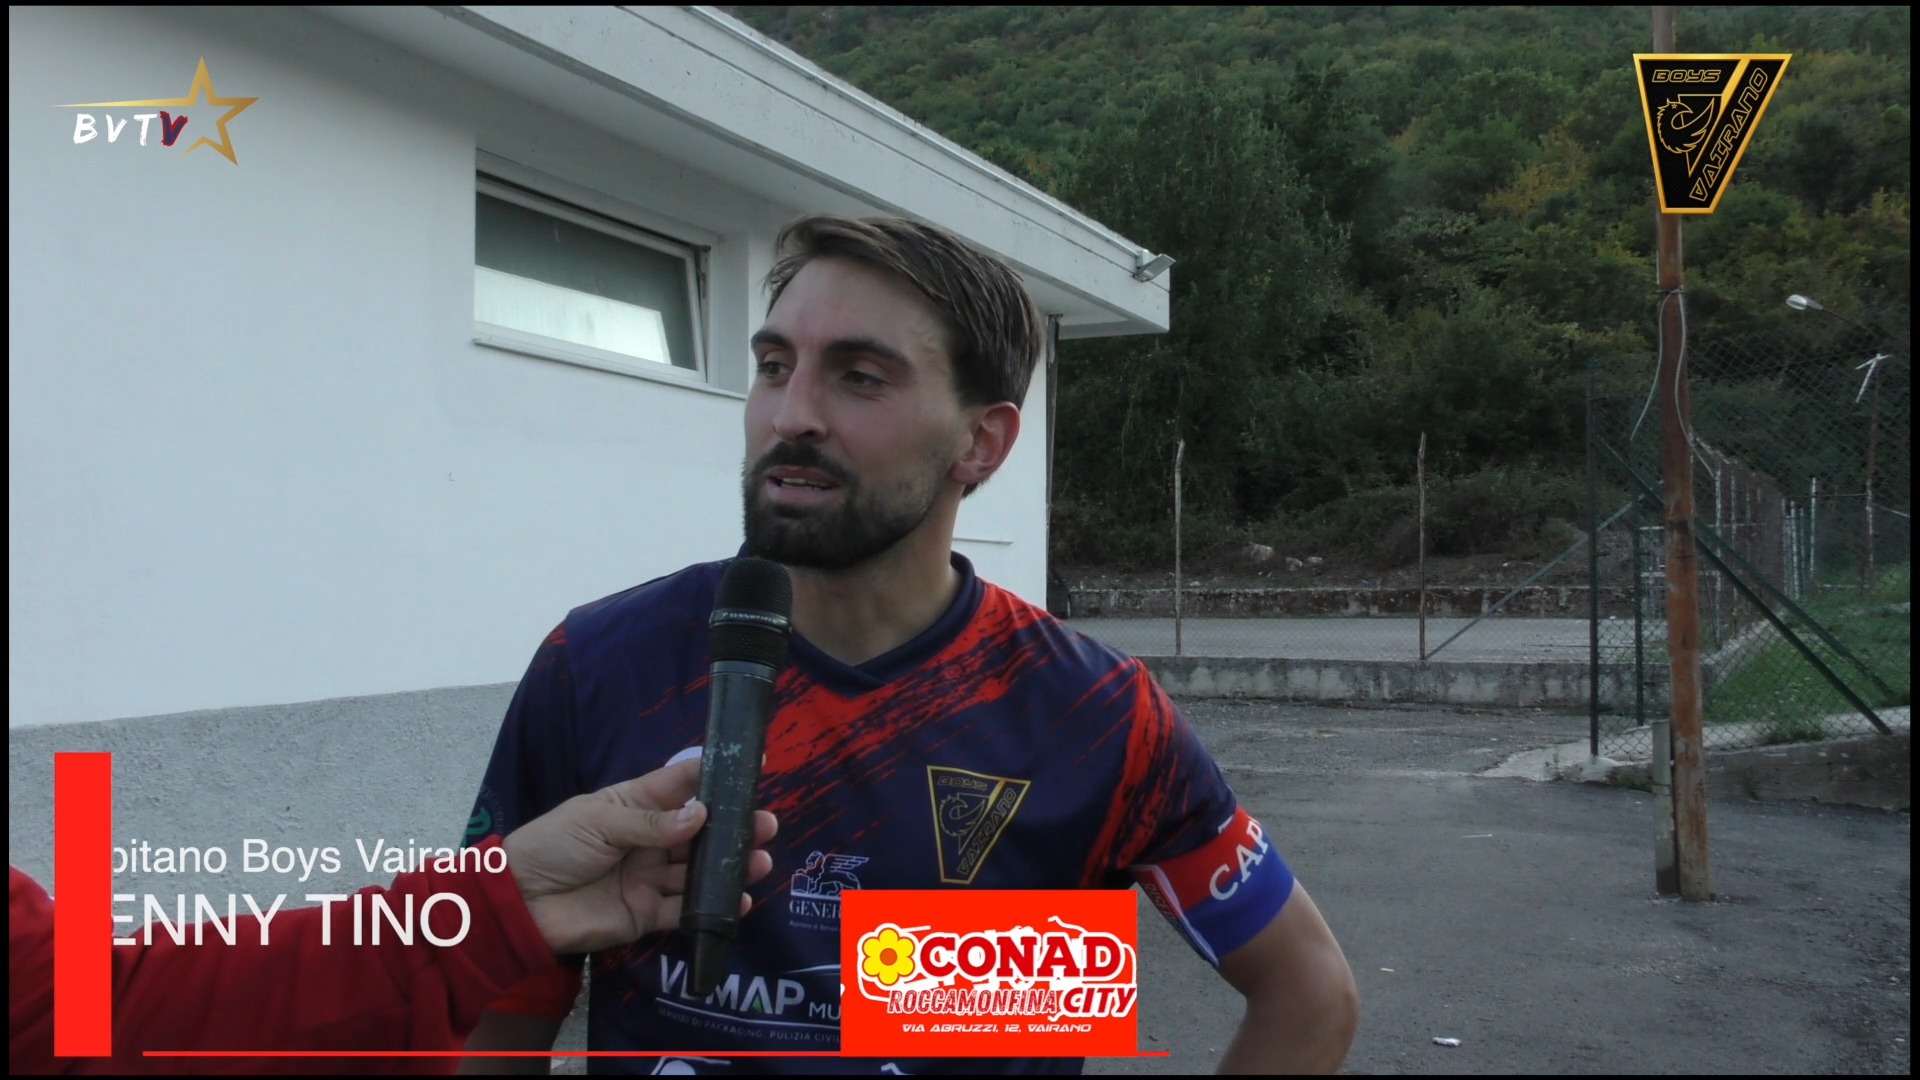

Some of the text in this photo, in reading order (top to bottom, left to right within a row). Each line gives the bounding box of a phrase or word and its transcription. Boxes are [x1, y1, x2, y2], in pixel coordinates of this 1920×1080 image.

[937, 776, 988, 791] BOYS
[957, 787, 1017, 875] VAIRANO
[769, 1030, 811, 1041] PULIZIA
